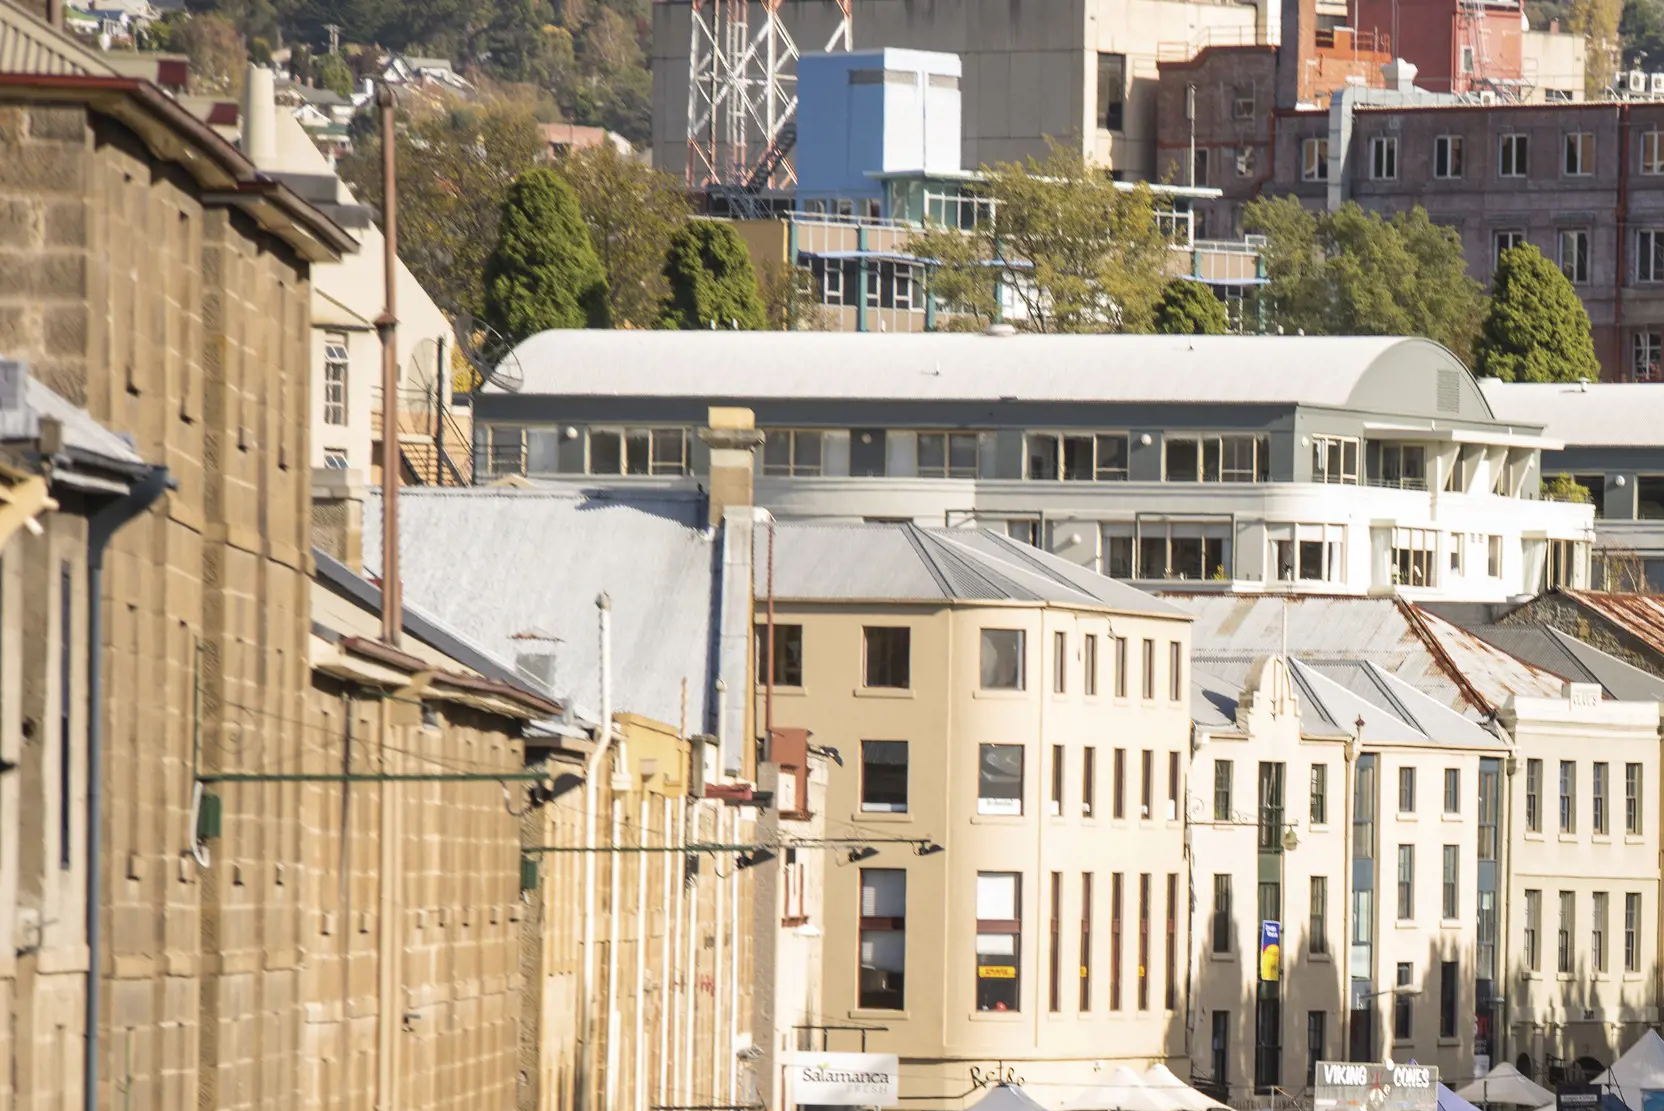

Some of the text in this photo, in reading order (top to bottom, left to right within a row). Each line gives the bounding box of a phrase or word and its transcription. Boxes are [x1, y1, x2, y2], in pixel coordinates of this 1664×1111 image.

[803, 1068, 889, 1084] Salamanca
[1324, 1064, 1430, 1088] VIKING CONES
